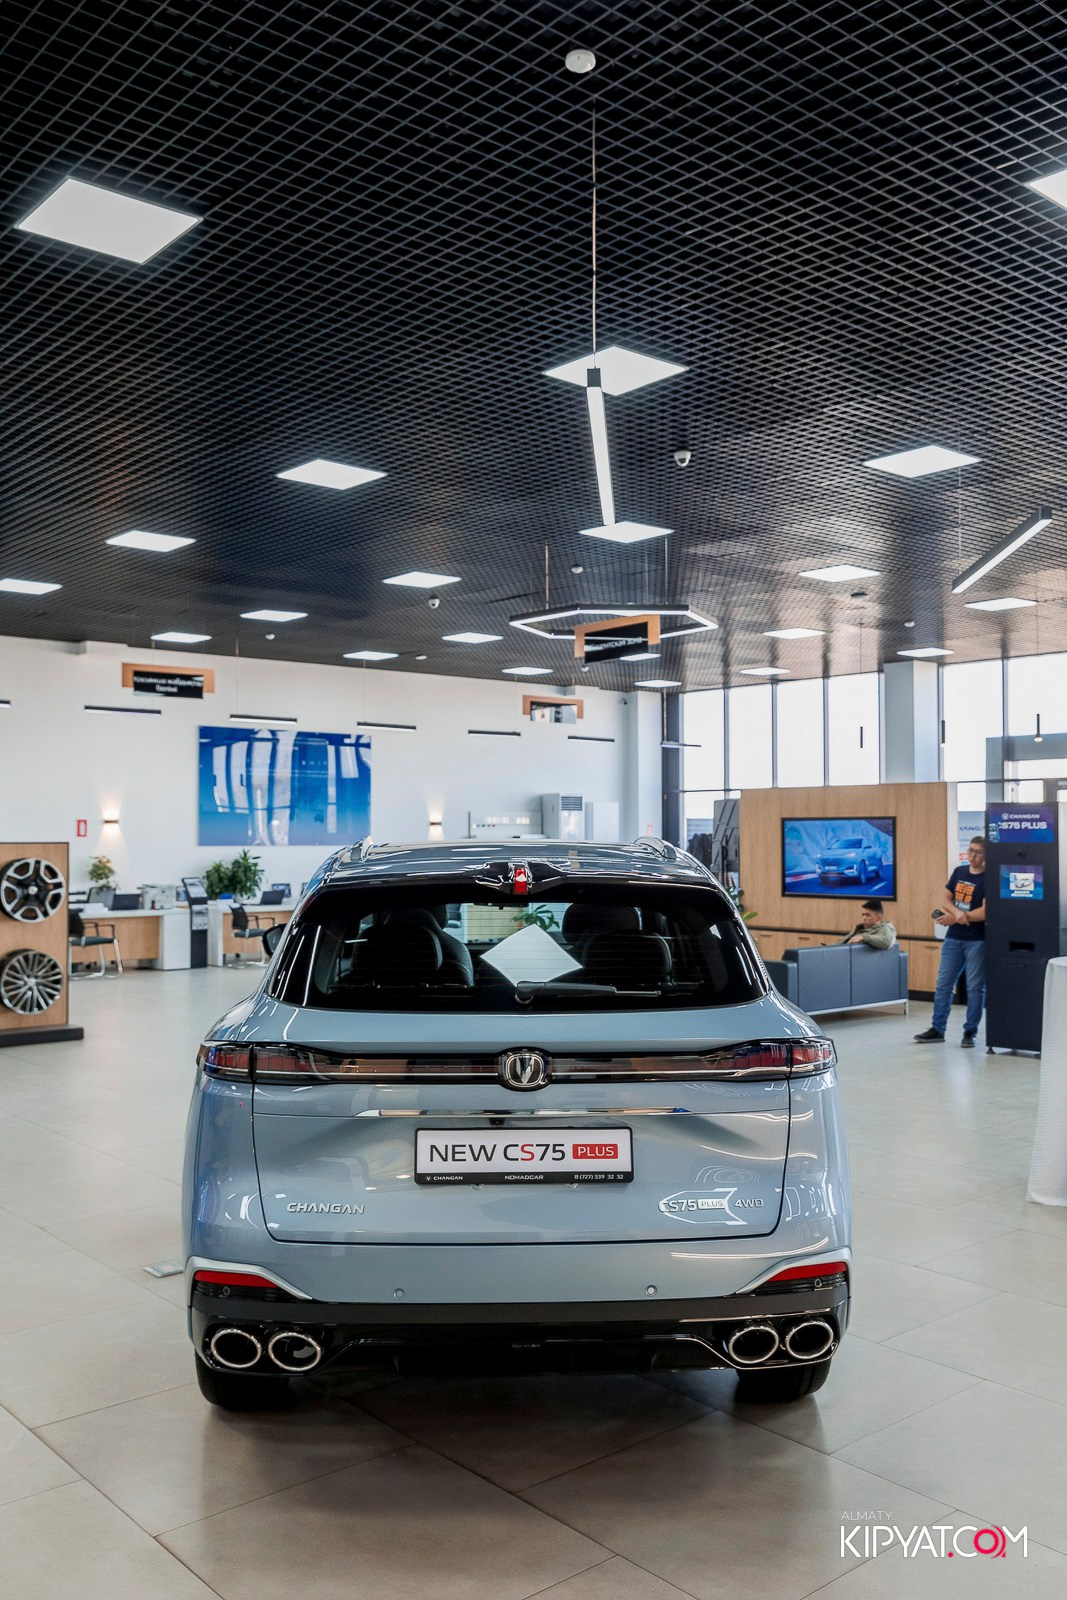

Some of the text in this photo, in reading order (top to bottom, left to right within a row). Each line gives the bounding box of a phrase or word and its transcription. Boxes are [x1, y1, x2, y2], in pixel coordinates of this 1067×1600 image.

[1022, 821, 1047, 829] PLUS
[429, 1143, 615, 1162] NEW CS75 PLUS
[285, 1202, 365, 1215] CHANGAN
[658, 1198, 764, 1212] CS75 PLUS 4WD
